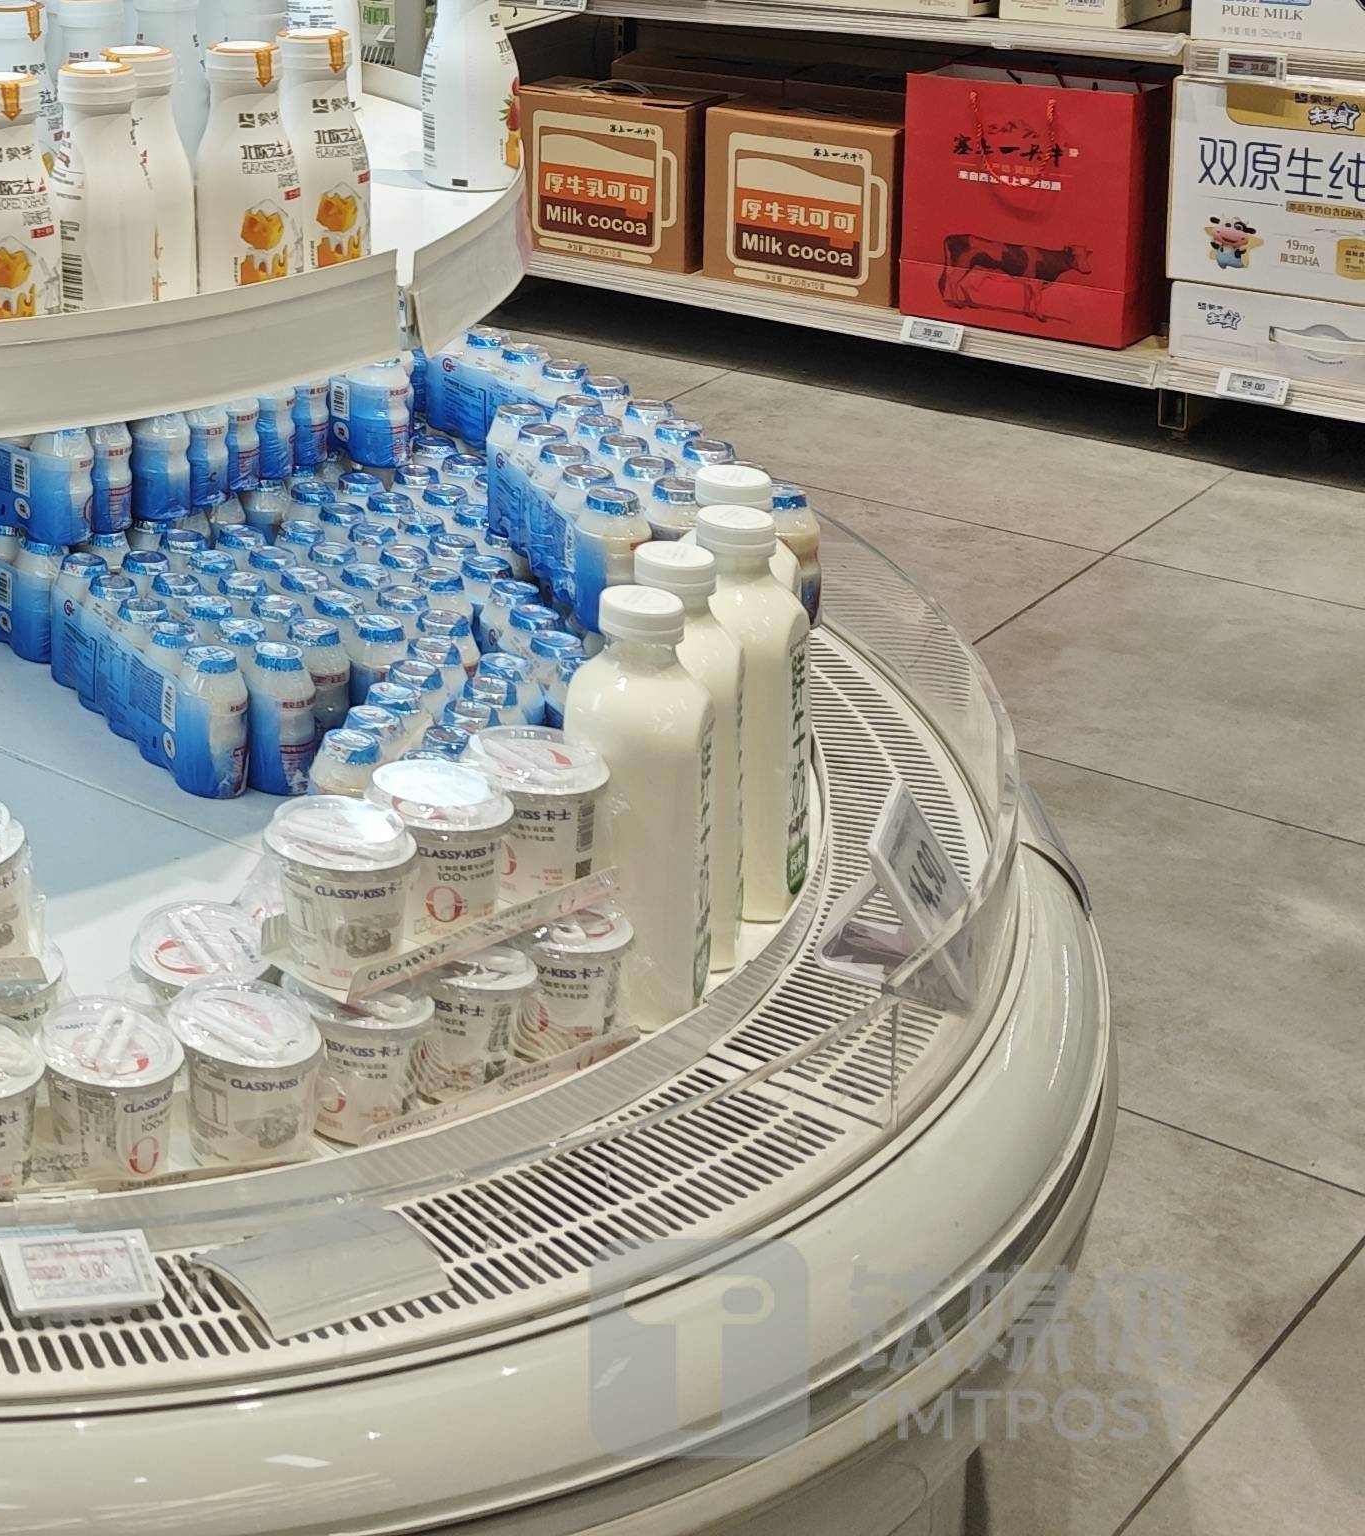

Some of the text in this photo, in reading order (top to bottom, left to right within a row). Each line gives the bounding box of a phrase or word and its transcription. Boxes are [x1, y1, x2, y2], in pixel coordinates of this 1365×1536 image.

[1221, 4, 1303, 21] PURE MILK
[1198, 136, 1365, 202] 双原生纯
[545, 172, 650, 205] 厚牛乳可可
[546, 204, 647, 236] Milk cocoa
[741, 198, 857, 234] 厚牛乳可可
[742, 232, 853, 267] Milk cocoa
[1279, 253, 1320, 267] 原生DHA
[1284, 239, 1316, 254] 19mg
